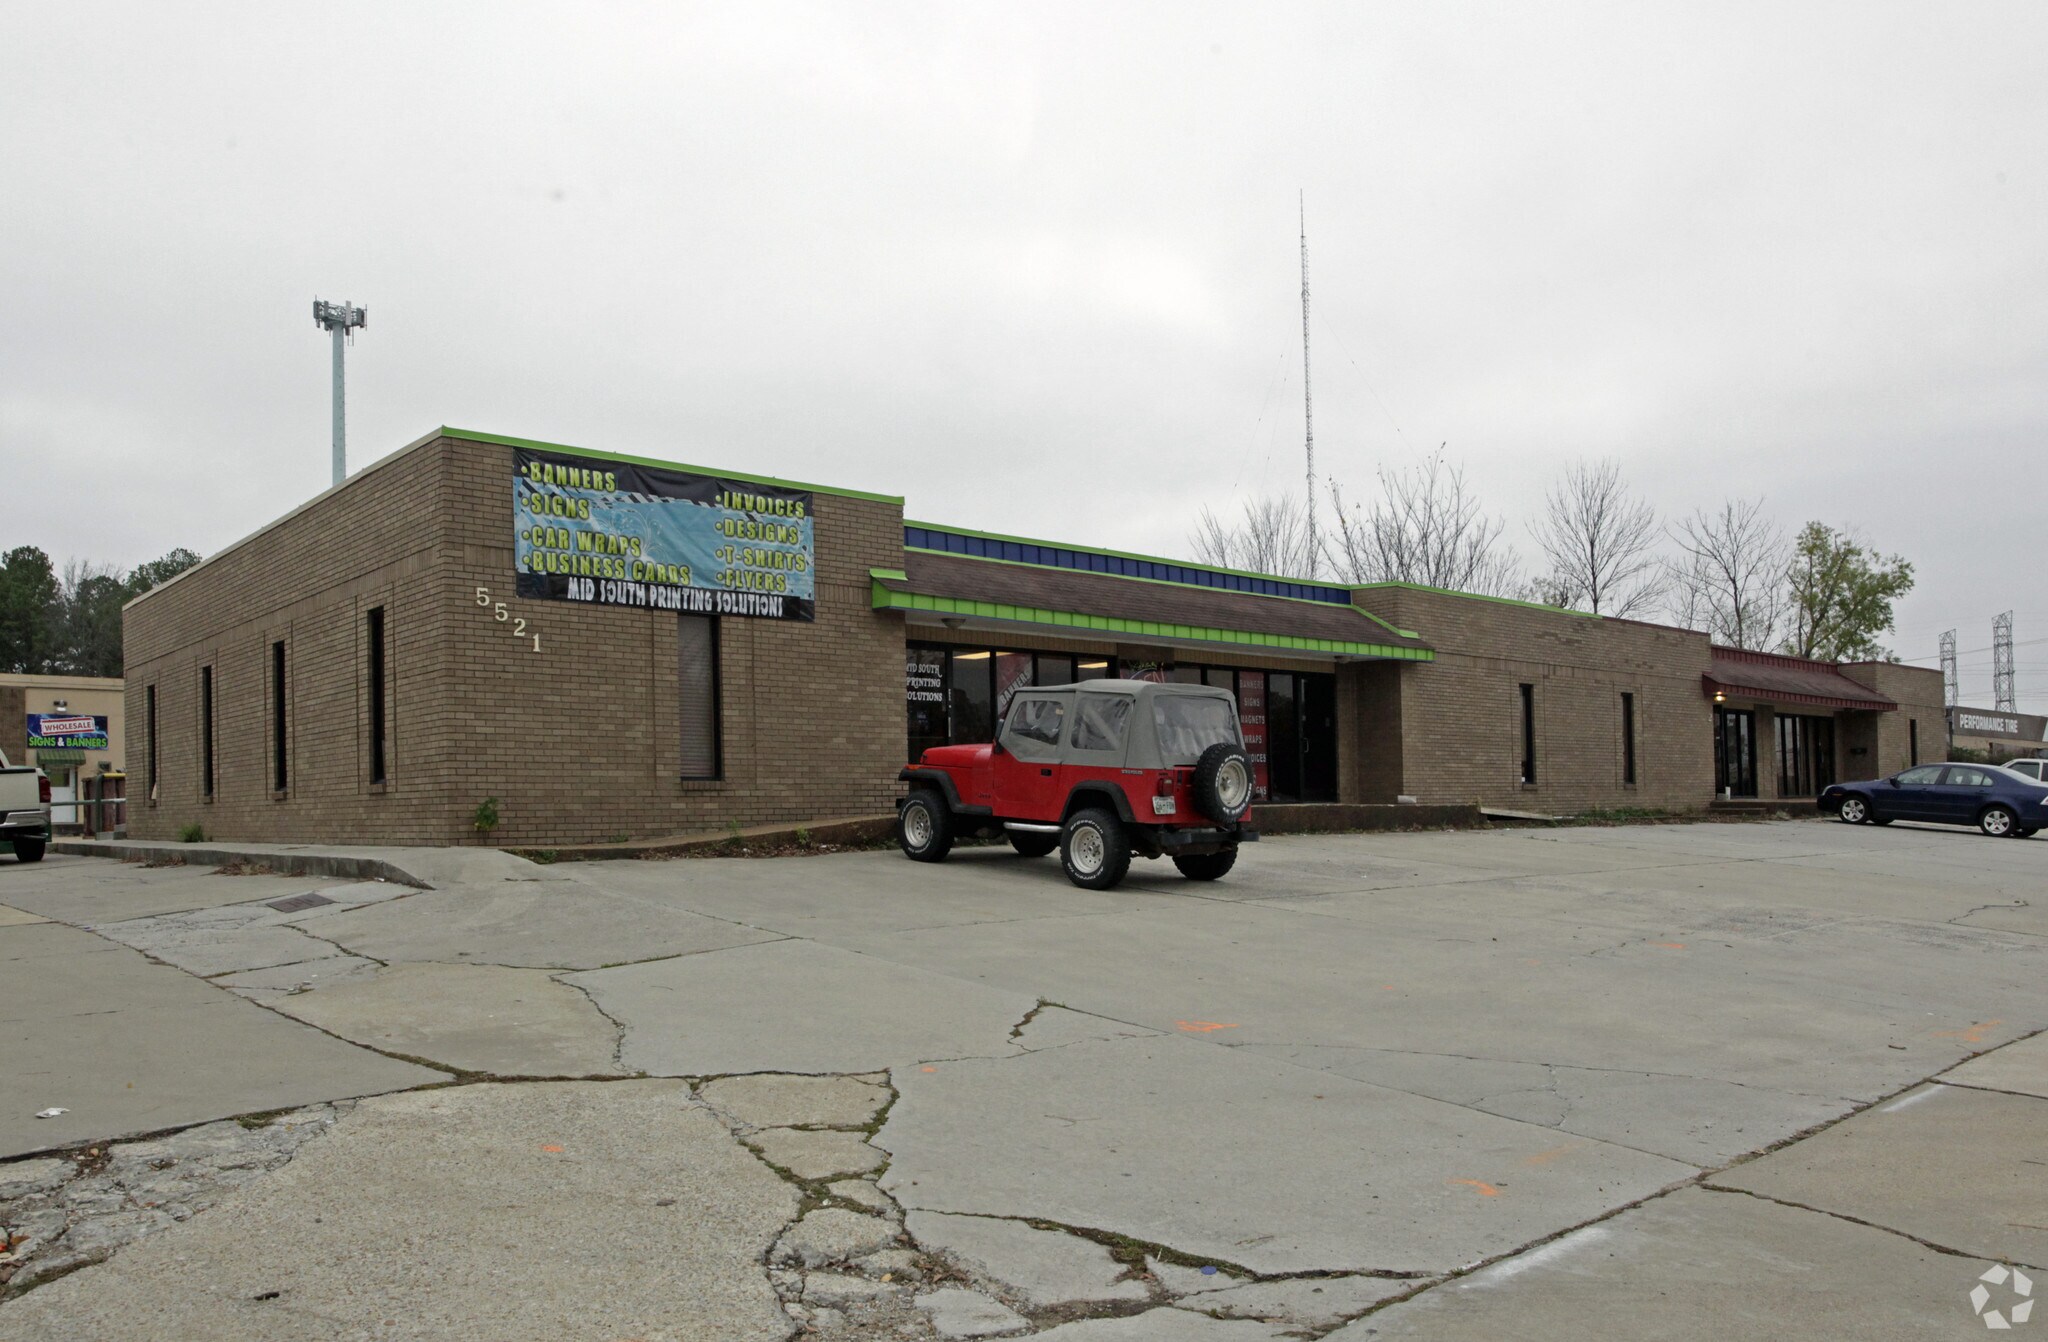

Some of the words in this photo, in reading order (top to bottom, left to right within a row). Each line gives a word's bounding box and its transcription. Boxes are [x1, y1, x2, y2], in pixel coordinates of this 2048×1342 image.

[530, 462, 616, 492] BANNERS
[531, 493, 589, 519] SIGNS
[724, 492, 804, 518] INVOICES
[532, 527, 570, 550] CAR
[576, 531, 641, 557] WRAPS
[724, 519, 798, 545] DESIGNS
[532, 551, 626, 580] BUSINESS
[632, 561, 690, 586] CARDS
[724, 546, 806, 572] T-SHIRTS
[725, 570, 787, 593] FLYERS
[567, 577, 595, 601] MID
[600, 580, 646, 606] SOUTH
[650, 586, 713, 613] PRINTING
[716, 592, 783, 618] SOLUTIONS
[476, 587, 540, 652] 5521
[918, 664, 942, 678] SOUTH
[906, 678, 941, 689] PRINTING
[1244, 697, 1260, 707] SIGNS
[44, 722, 91, 732] WHOLESALE
[1240, 714, 1265, 725] MAGNETS
[1960, 714, 2004, 732] PERFORMANCE
[2005, 719, 2018, 734] TIRE
[28, 737, 56, 747] SIGNS
[58, 736, 64, 747] &
[66, 737, 107, 748] BANNERS
[1244, 735, 1262, 744] WRAPS
